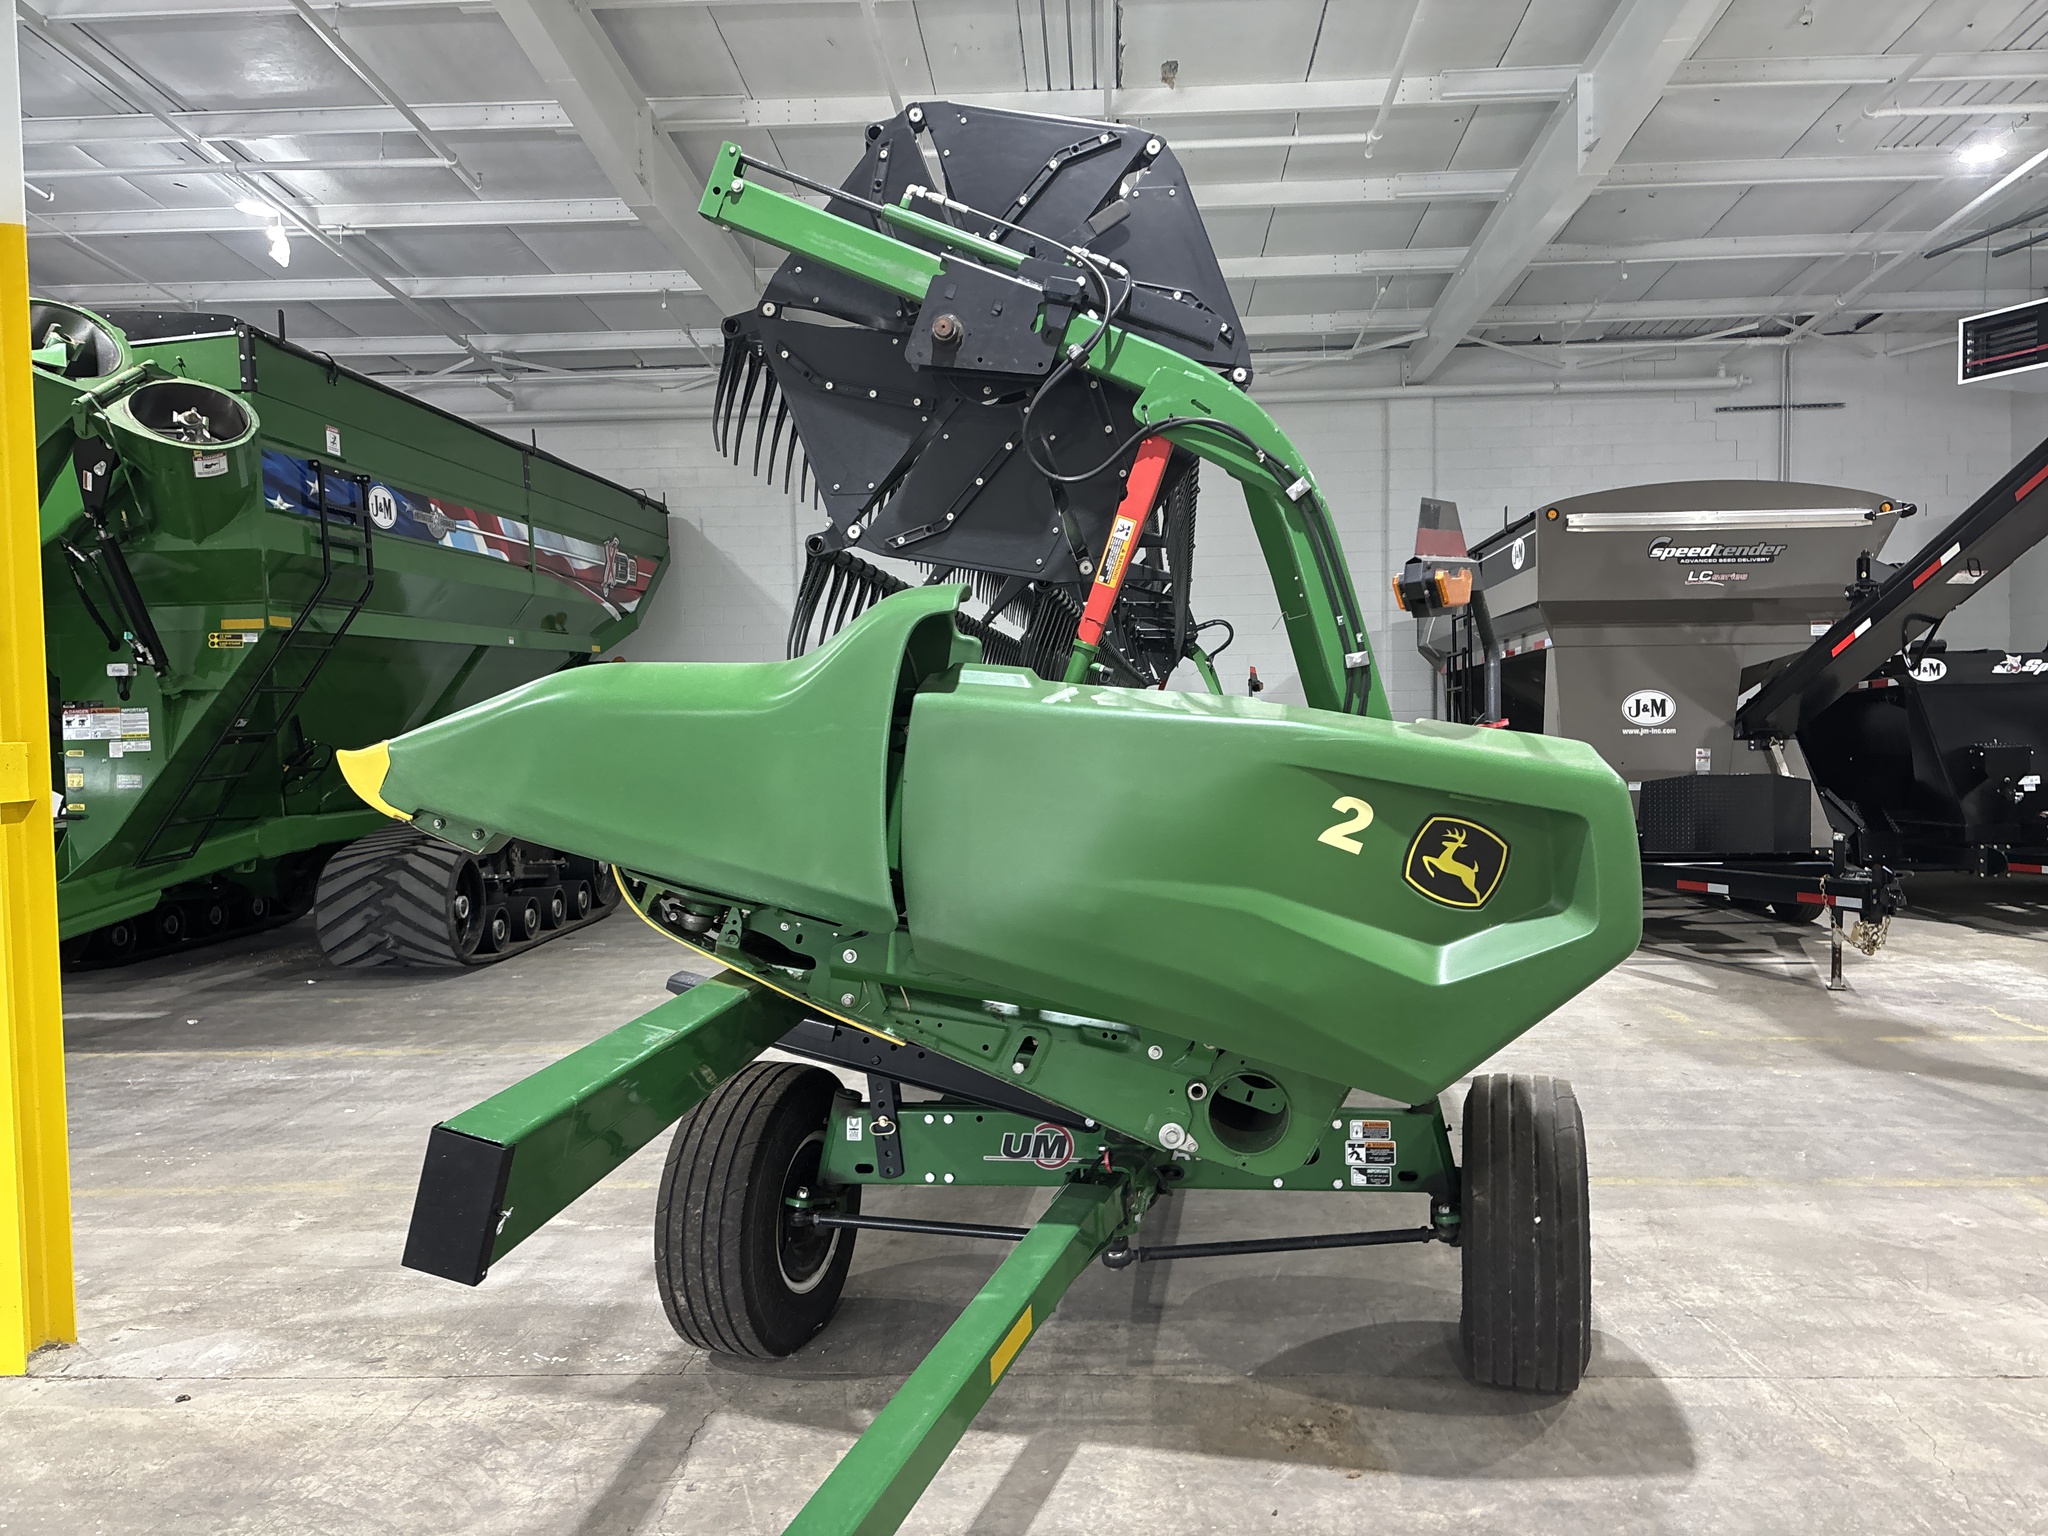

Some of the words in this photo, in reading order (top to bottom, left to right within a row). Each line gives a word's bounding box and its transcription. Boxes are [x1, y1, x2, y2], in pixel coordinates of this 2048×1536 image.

[371, 495, 393, 520] J&M
[1113, 555, 1124, 580] WARNING
[1628, 699, 1667, 717] J&M
[1622, 727, 1677, 736] www.jm-inc.com
[1317, 795, 1374, 856] 2
[1001, 1133, 1068, 1159] UM
